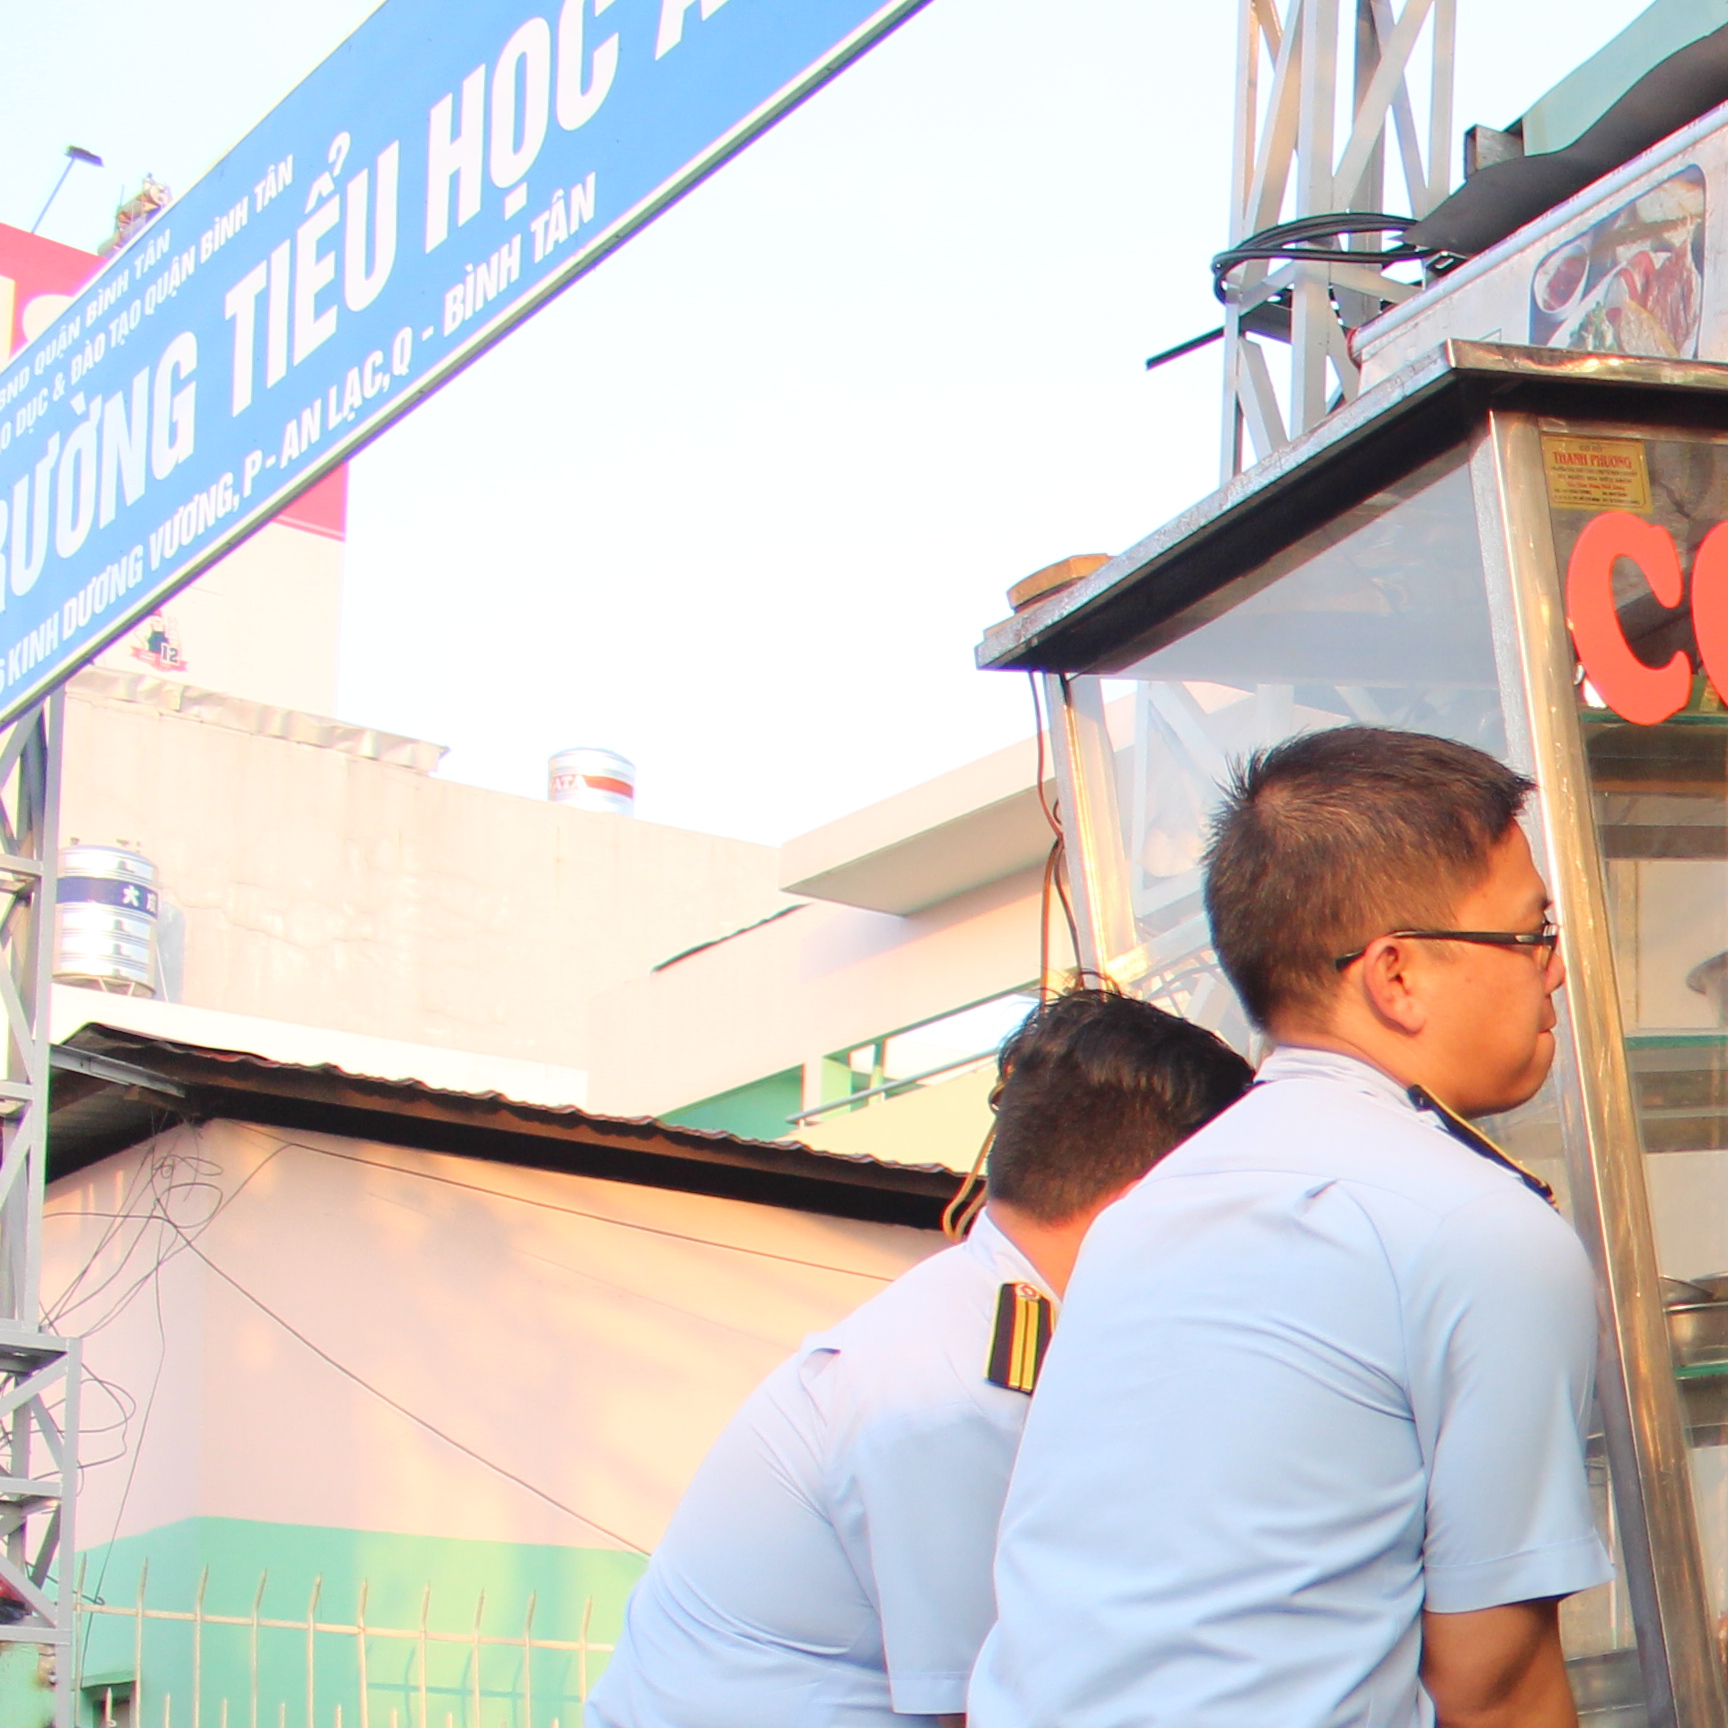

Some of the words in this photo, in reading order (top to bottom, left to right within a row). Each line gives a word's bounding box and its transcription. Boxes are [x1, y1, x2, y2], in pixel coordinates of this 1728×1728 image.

[15, 387, 49, 438] DỤC
[70, 332, 107, 386] ĐÀO
[108, 299, 141, 349] TẠO
[143, 244, 196, 316] QUẬN
[199, 195, 249, 264] BÌNH
[254, 153, 294, 214] TÂN
[34, 315, 81, 377] QUẬN
[85, 268, 129, 328] BÌNH
[134, 228, 171, 280] TÂN
[224, 131, 399, 418] TIỂU
[425, 0, 619, 255] HỌC
[7, 611, 60, 687] KINH
[62, 544, 144, 641] DƯƠNG
[149, 471, 240, 572] VƯƠNG,
[279, 398, 322, 470] AN
[443, 233, 522, 338] BÌNH
[530, 171, 596, 264] TÂN
